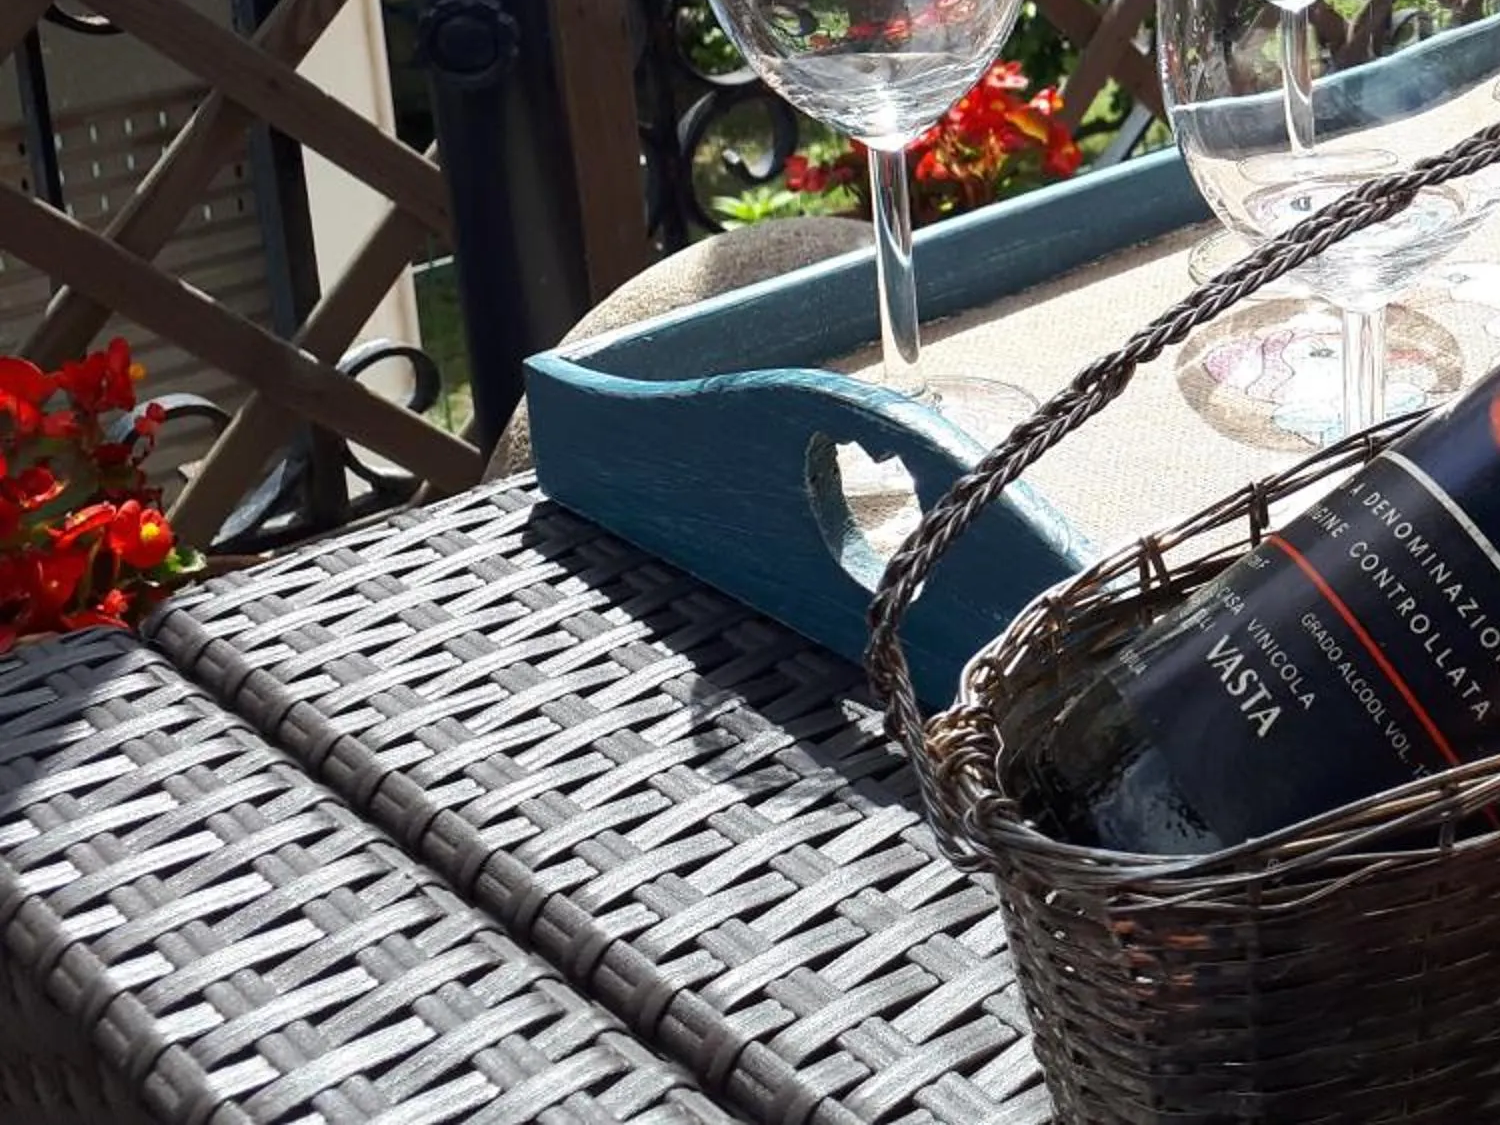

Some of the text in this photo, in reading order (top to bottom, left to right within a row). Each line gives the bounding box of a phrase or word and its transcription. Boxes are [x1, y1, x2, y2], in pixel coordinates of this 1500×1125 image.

[1246, 618, 1317, 711] VINICOLA
[1300, 611, 1344, 663] GRADO
[1336, 661, 1389, 726] ALCOOL
[1349, 540, 1492, 721] CONTROLLATA
[1205, 633, 1283, 739] VASTA
